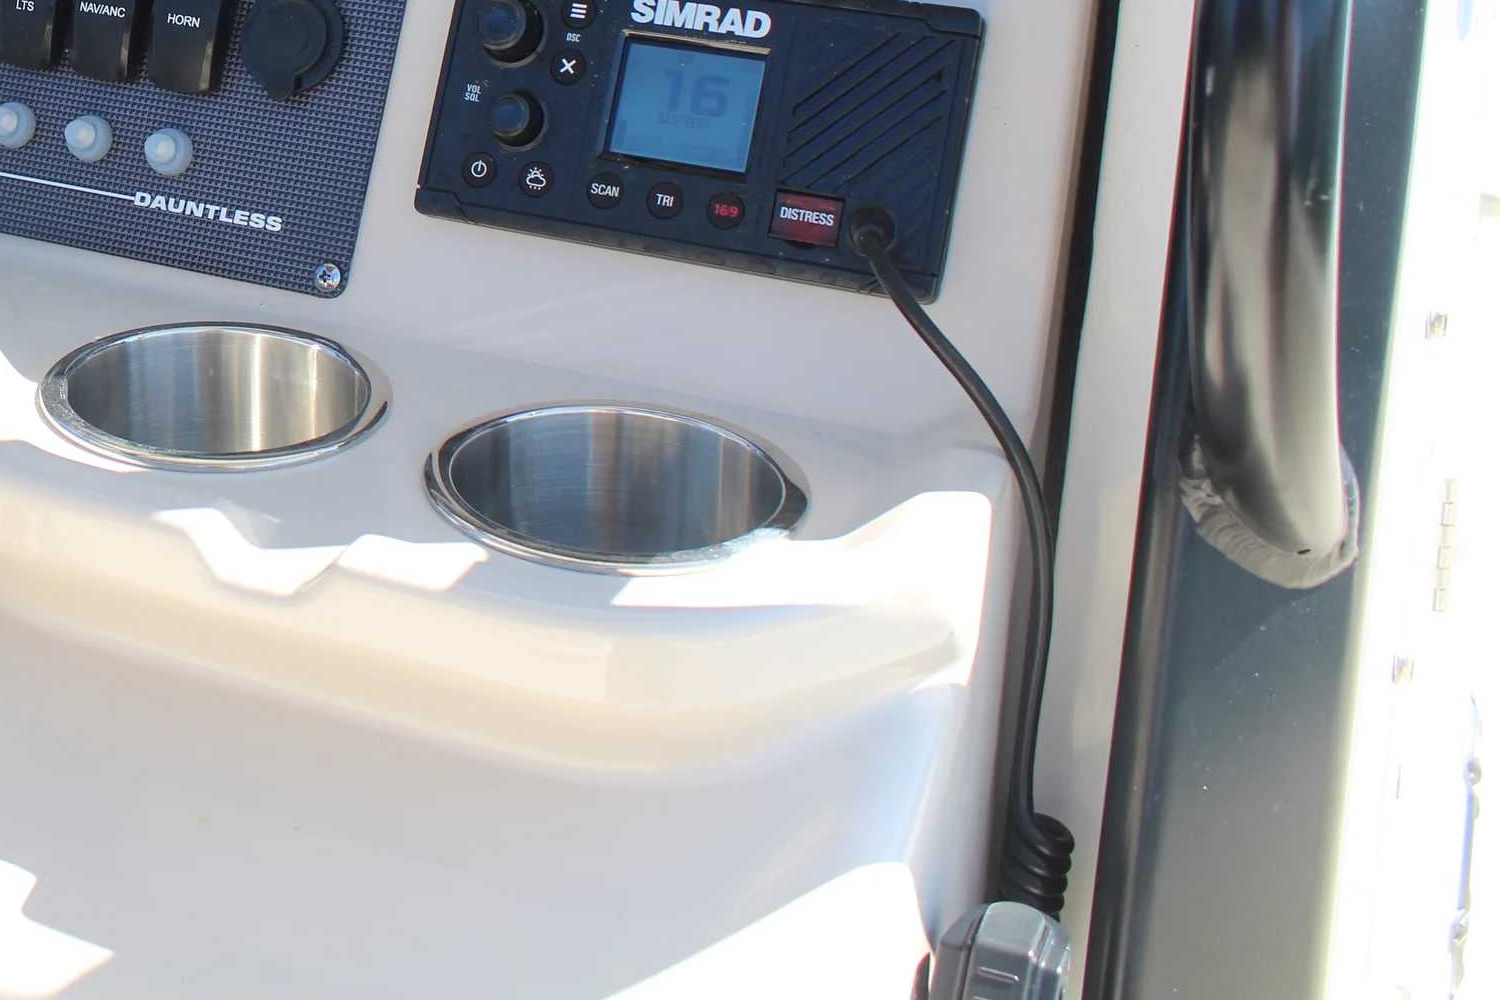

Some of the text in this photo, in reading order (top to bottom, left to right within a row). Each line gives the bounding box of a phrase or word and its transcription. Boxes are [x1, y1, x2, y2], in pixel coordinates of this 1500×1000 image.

[15, 0, 35, 12] LTS
[79, 1, 126, 18] NAV/ANC
[167, 13, 201, 28] HORN
[566, 32, 581, 43] DSC
[466, 83, 481, 95] VOL
[664, 69, 730, 118] 16
[464, 92, 480, 103] SQL
[590, 183, 620, 197] SCAN
[656, 193, 674, 208] TRI
[133, 191, 283, 232] DAUNTLESS
[714, 203, 739, 218] 16/9
[779, 206, 835, 227] DISTRESS
